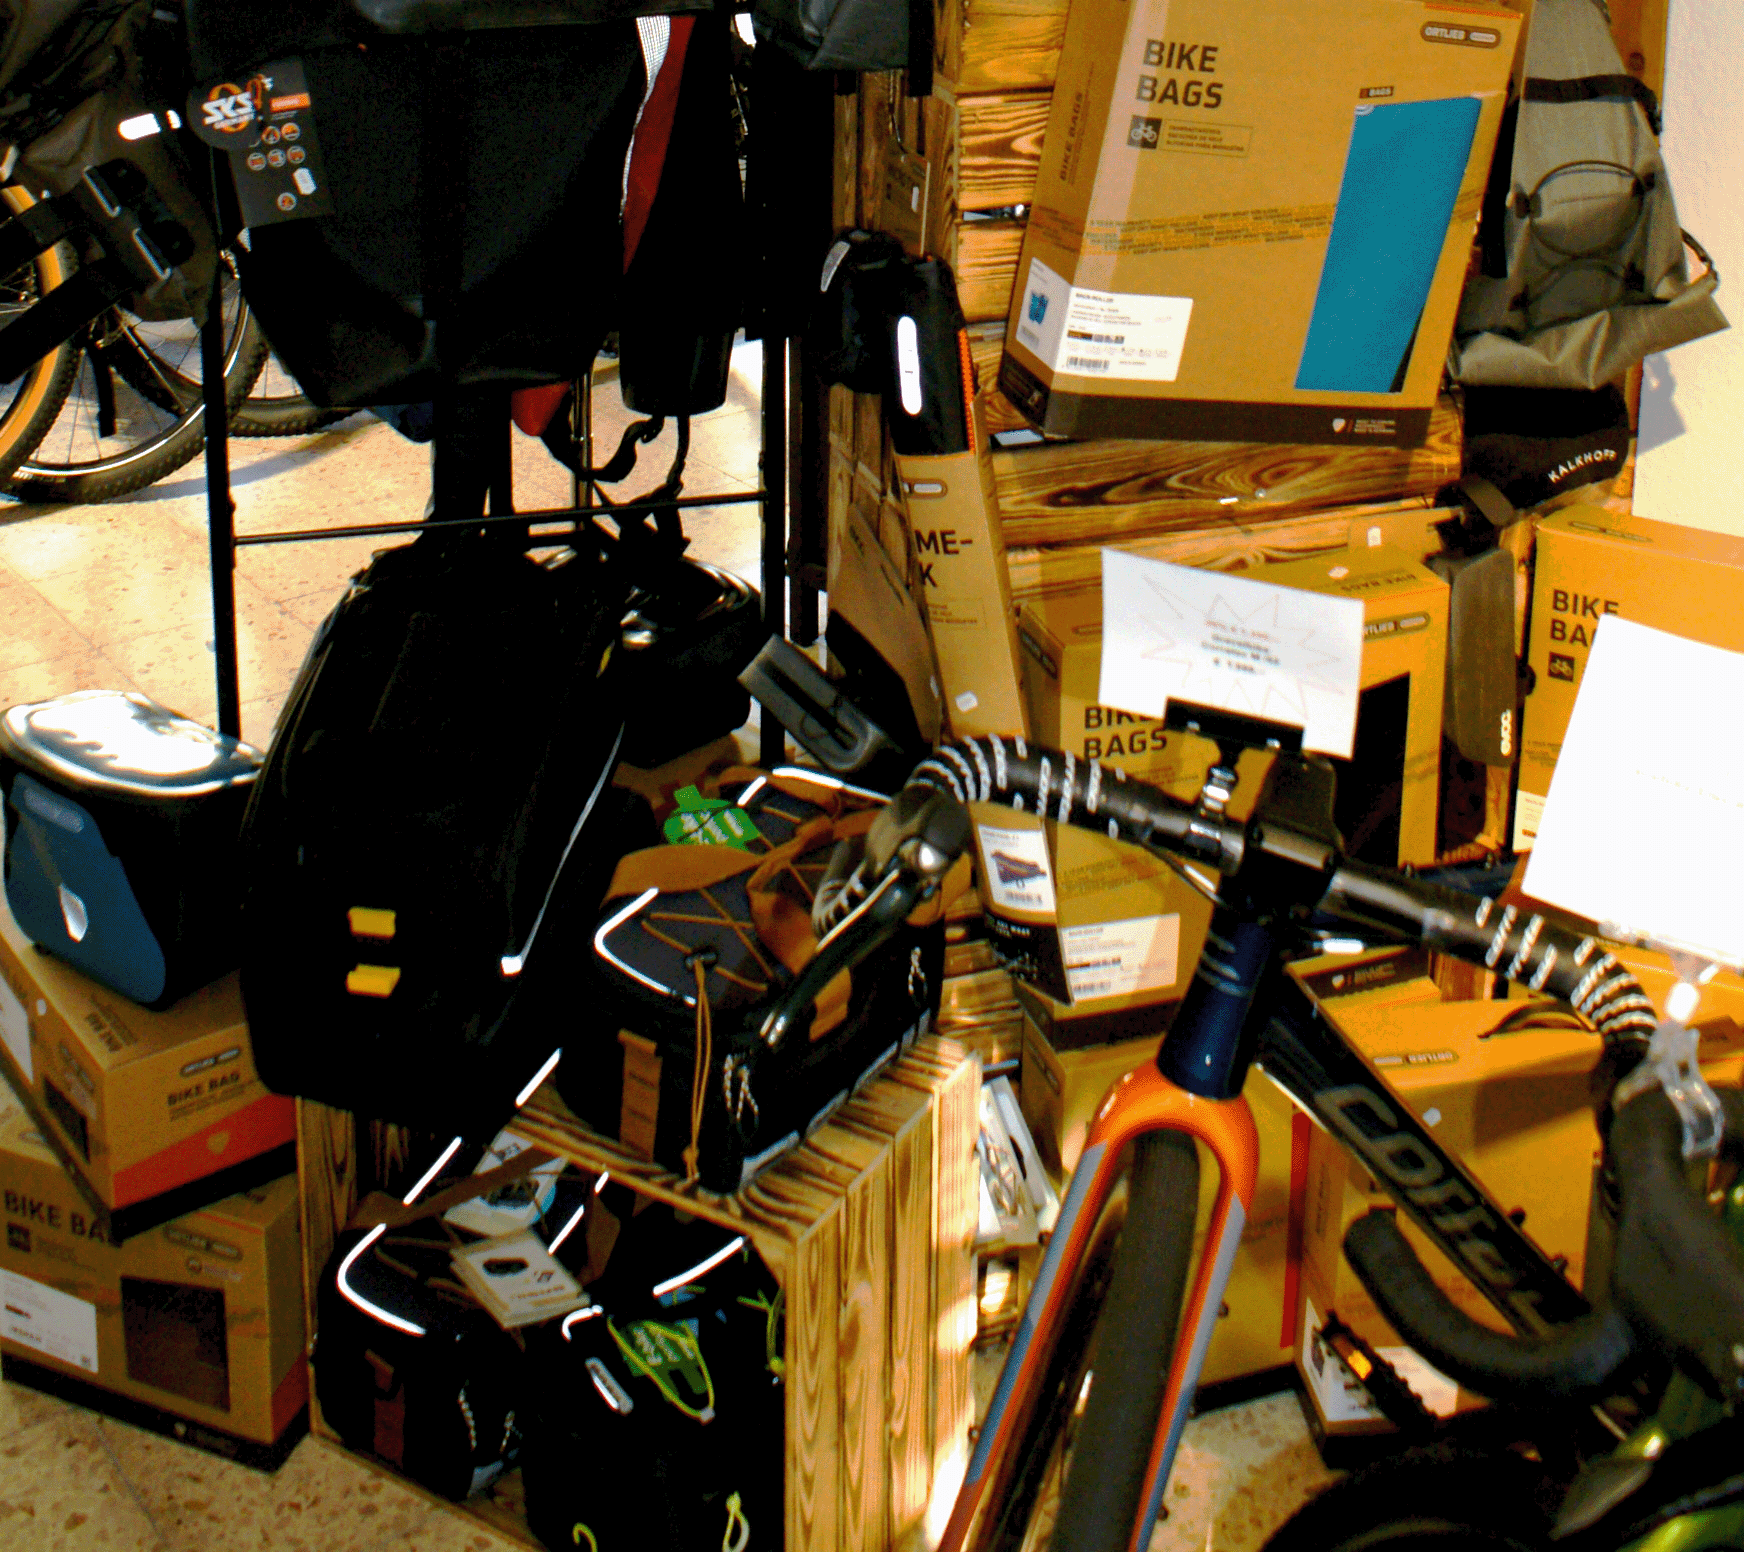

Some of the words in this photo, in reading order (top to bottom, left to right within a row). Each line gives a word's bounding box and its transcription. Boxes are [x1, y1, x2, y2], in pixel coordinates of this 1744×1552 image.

[1424, 25, 1466, 40] ORTLIEB
[1143, 39, 1219, 73] BIKE
[202, 91, 255, 126] SKS
[1136, 74, 1224, 109] BAGS
[1547, 448, 1617, 484] KALKHOFF
[914, 529, 973, 555] ME-
[1550, 618, 1597, 648] BA
[1085, 706, 1155, 729] BIK
[1084, 727, 1167, 759] BAGS
[167, 1084, 202, 1107] BIKE
[207, 1072, 240, 1093] BAG
[4, 1189, 62, 1230] BIKE
[70, 1211, 107, 1244] BA
